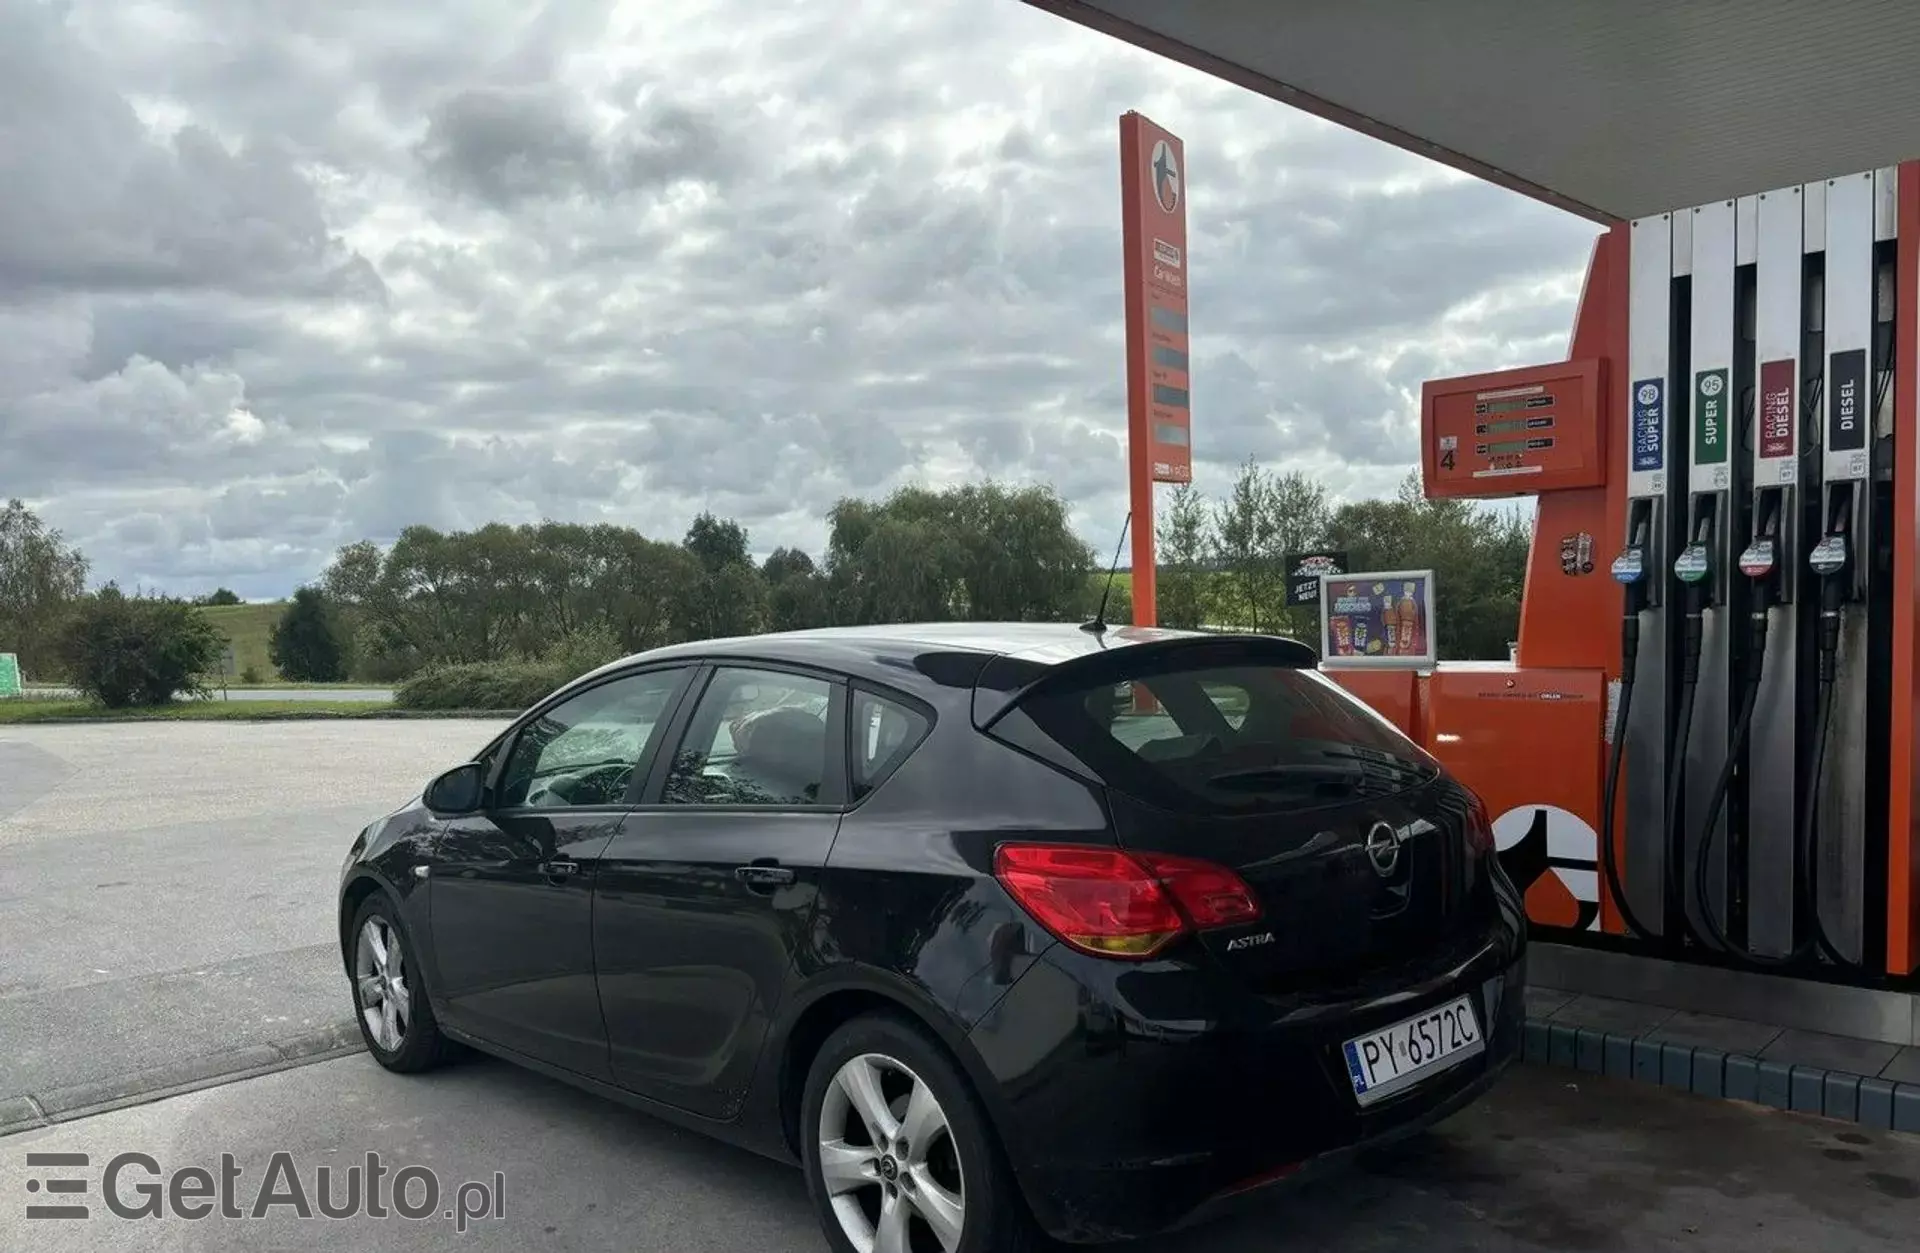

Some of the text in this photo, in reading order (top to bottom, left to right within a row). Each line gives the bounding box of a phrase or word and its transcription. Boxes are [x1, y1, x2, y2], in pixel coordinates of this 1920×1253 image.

[1641, 388, 1656, 400] 98
[1704, 379, 1719, 392] 95
[1841, 379, 1854, 430] DIESEL
[1637, 409, 1647, 453] RACING
[1647, 408, 1659, 452] SUPER
[1705, 400, 1718, 445] SUPER
[1764, 392, 1776, 439] RACING
[1776, 387, 1789, 437] DIESEL
[1440, 450, 1456, 471] 4
[1294, 580, 1317, 594] JETZT
[1227, 932, 1275, 951] ASTRA
[1362, 1004, 1474, 1083] PY 6572C
